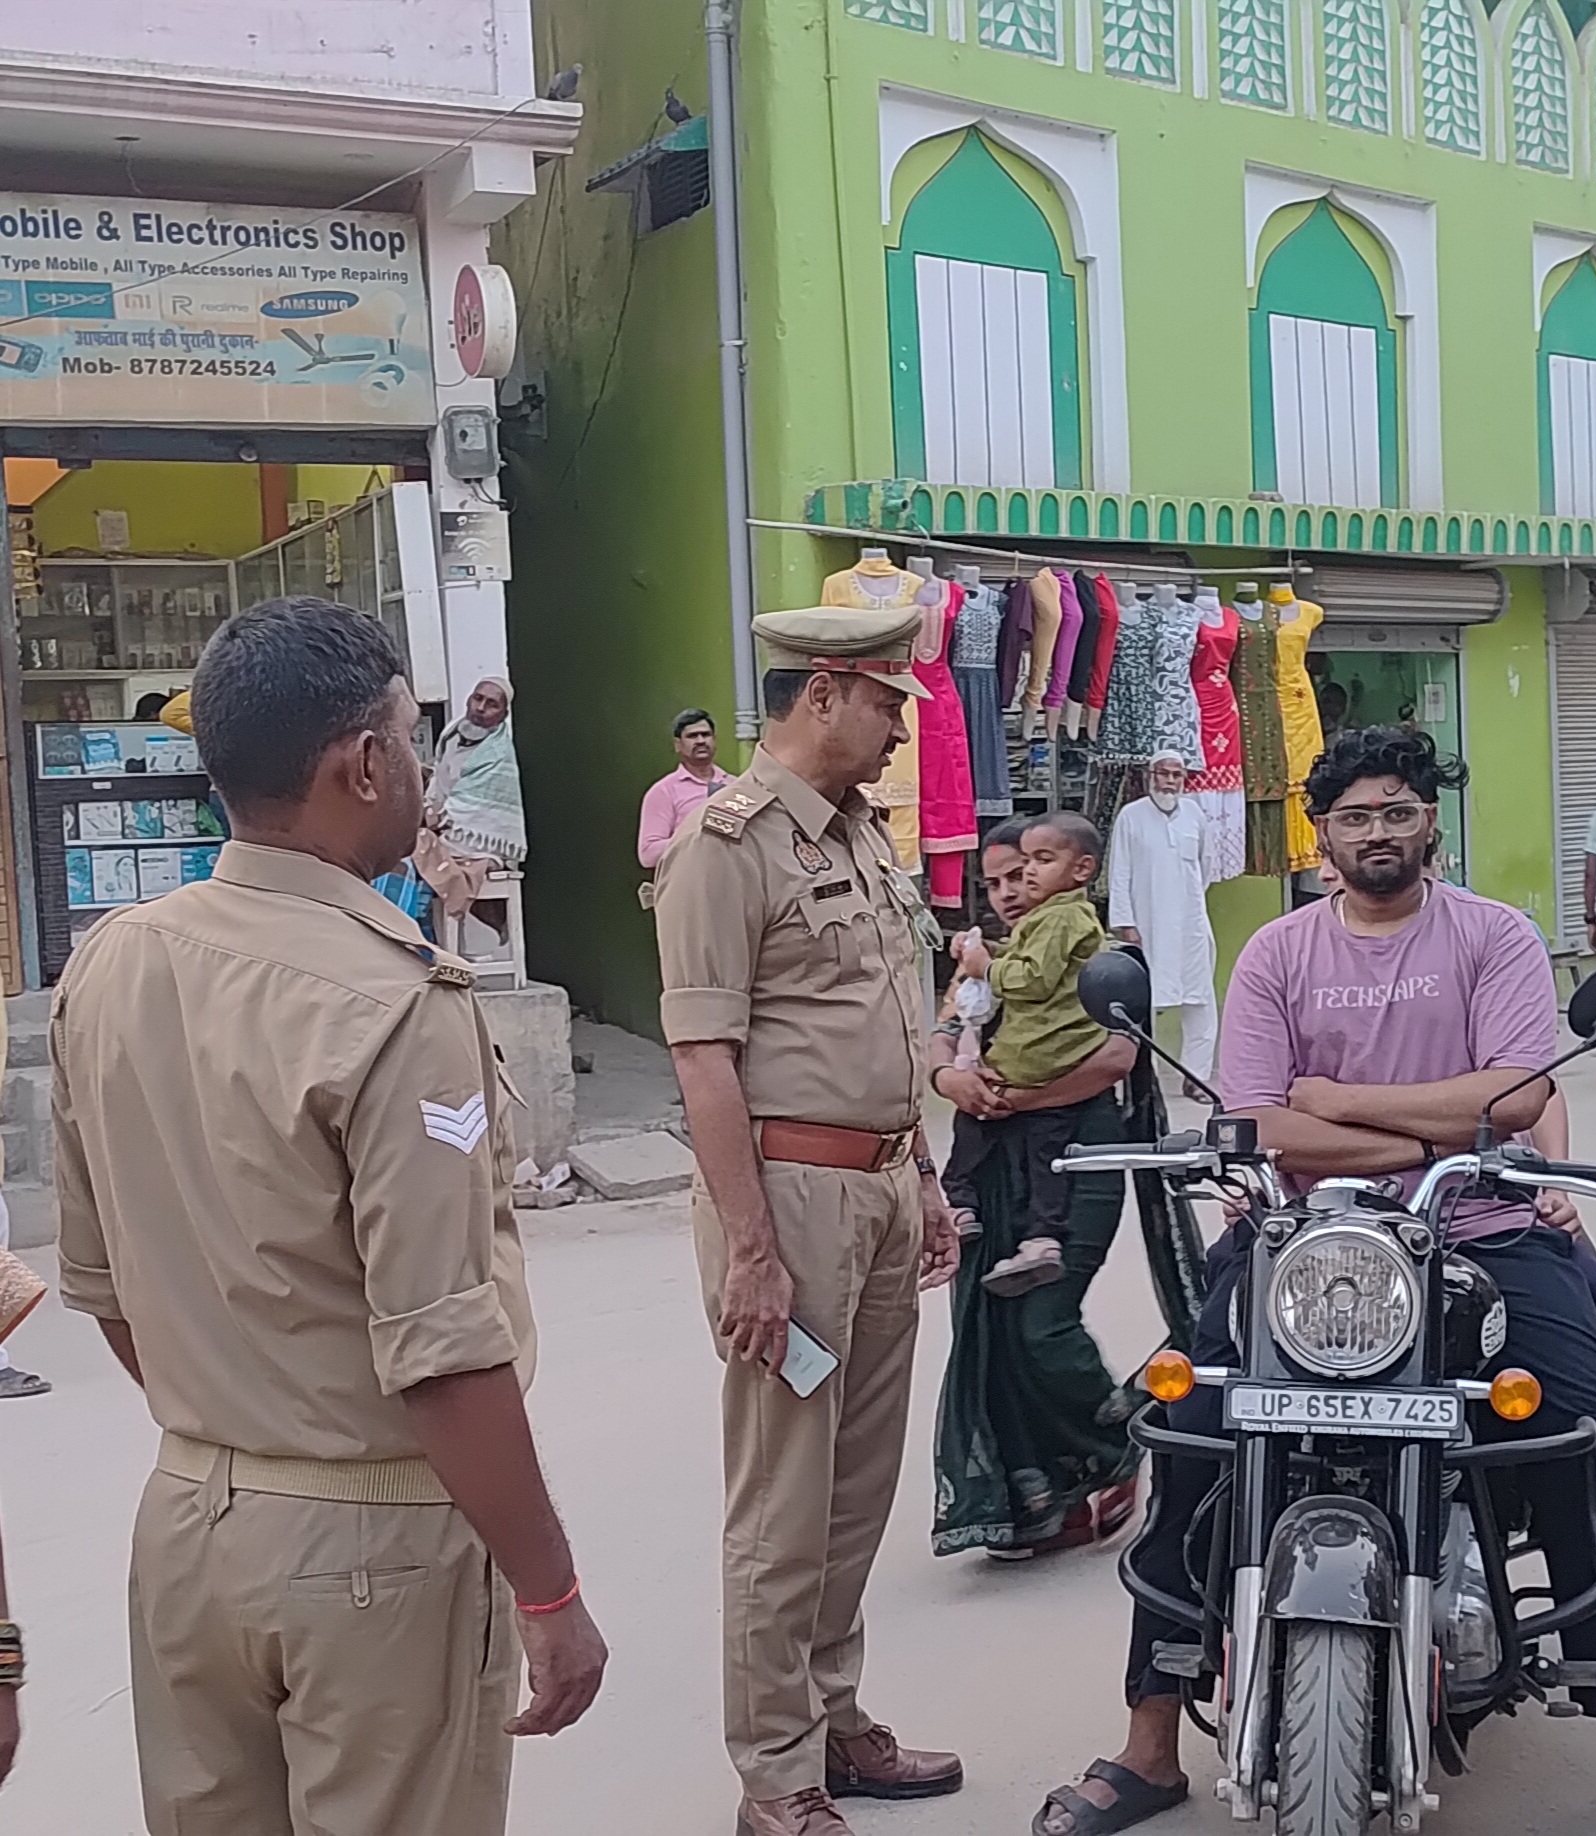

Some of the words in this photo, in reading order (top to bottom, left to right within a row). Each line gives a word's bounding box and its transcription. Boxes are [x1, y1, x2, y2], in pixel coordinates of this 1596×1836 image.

[96, 211, 121, 241] &
[132, 211, 319, 250] Electronics
[329, 221, 405, 260] Shop
[2, 255, 41, 272] Type
[46, 257, 98, 272] Mobile
[113, 259, 133, 273] All
[138, 260, 176, 277] Type
[181, 262, 272, 279] Accessories
[278, 265, 297, 279] All
[301, 266, 337, 282] Type
[341, 267, 409, 285] Repairing
[201, 302, 249, 313] realme
[272, 298, 348, 311] SAMSUNG
[160, 328, 176, 347] की
[180, 330, 216, 353] पुरानी
[62, 356, 121, 374] Mob-
[130, 358, 276, 376] 8787245524
[1312, 974, 1440, 1009] TECHSCAPE
[1261, 1393, 1292, 1416] UP
[1306, 1395, 1373, 1420] 65EX
[1386, 1398, 1453, 1423] 7425
